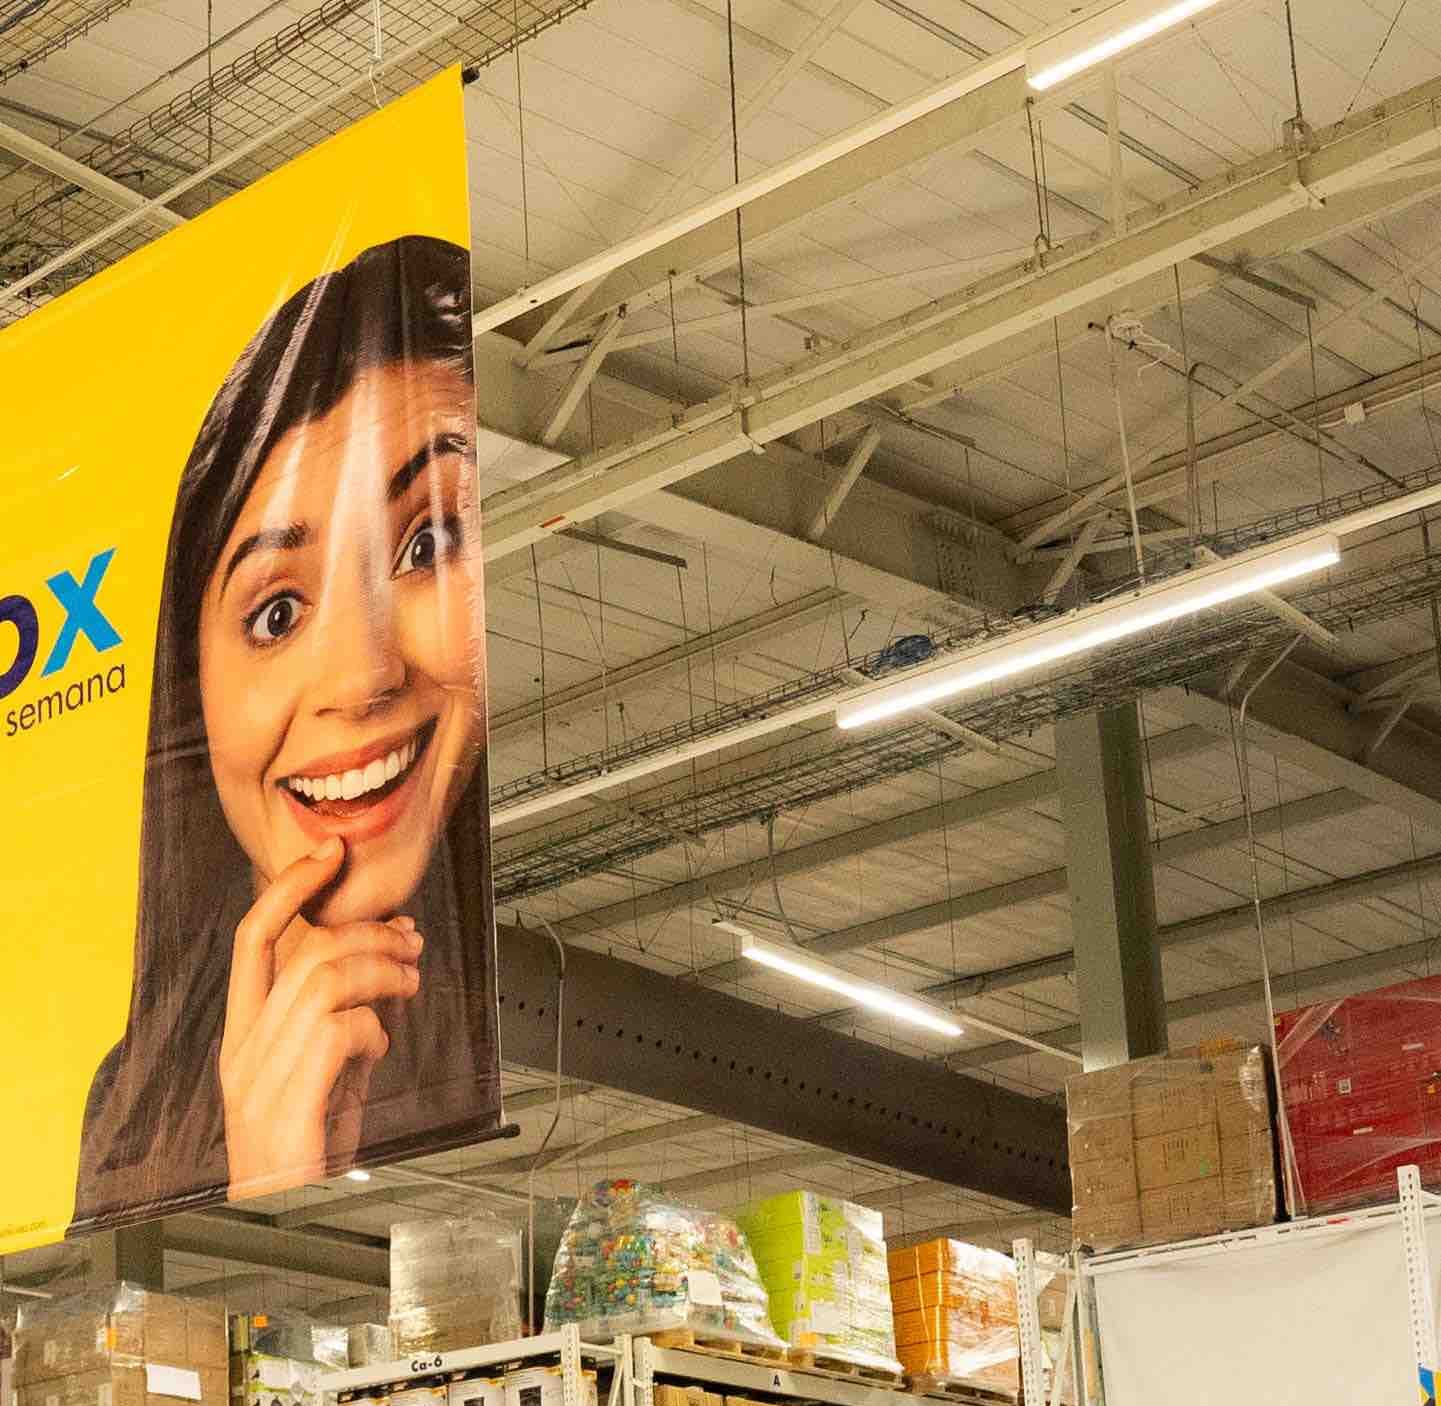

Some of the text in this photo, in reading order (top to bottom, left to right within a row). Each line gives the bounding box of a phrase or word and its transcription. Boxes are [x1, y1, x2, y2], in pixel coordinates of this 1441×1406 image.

[5, 664, 126, 736] semana
[411, 1357, 443, 1373] Ca-6
[773, 1375, 781, 1387] A
